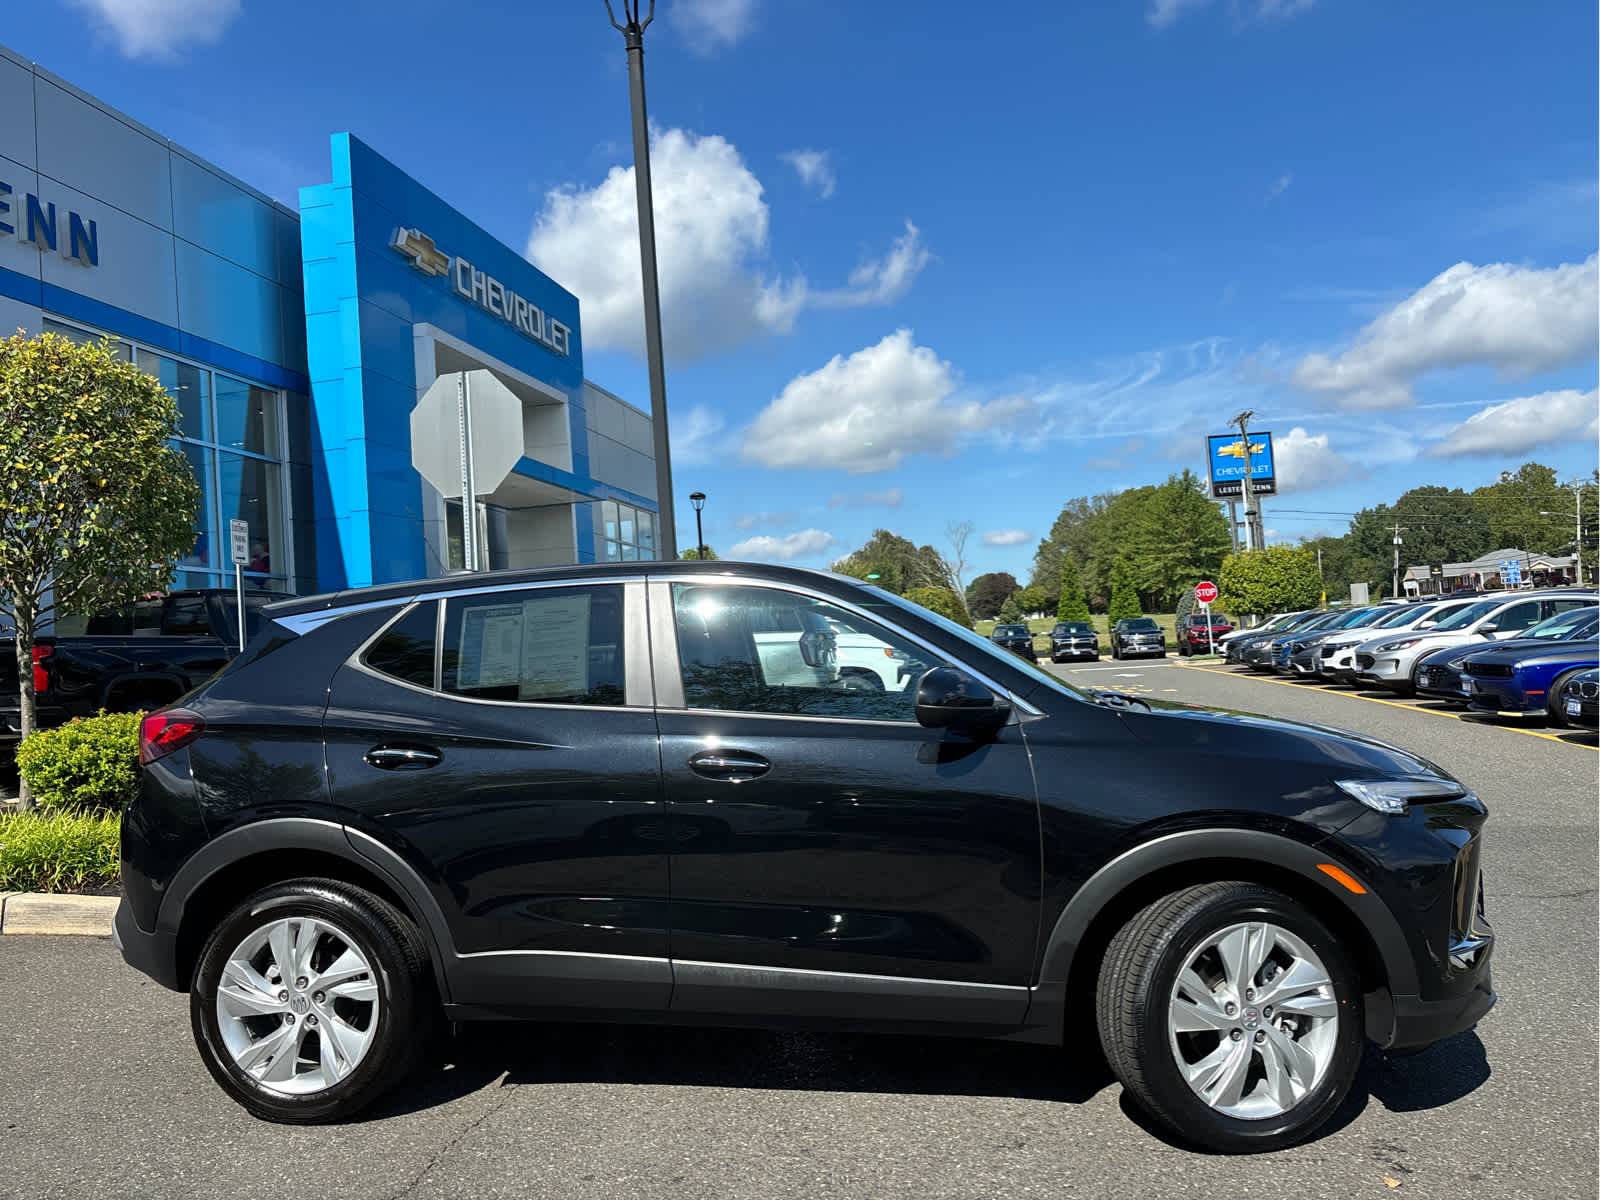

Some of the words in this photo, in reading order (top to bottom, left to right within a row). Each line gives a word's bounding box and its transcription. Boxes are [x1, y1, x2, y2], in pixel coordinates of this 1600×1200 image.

[450, 256, 571, 357] CHEVROLET
[1216, 465, 1269, 476] CHEVRLET
[1218, 486, 1246, 494] LESTE
[1196, 588, 1216, 597] STOP
